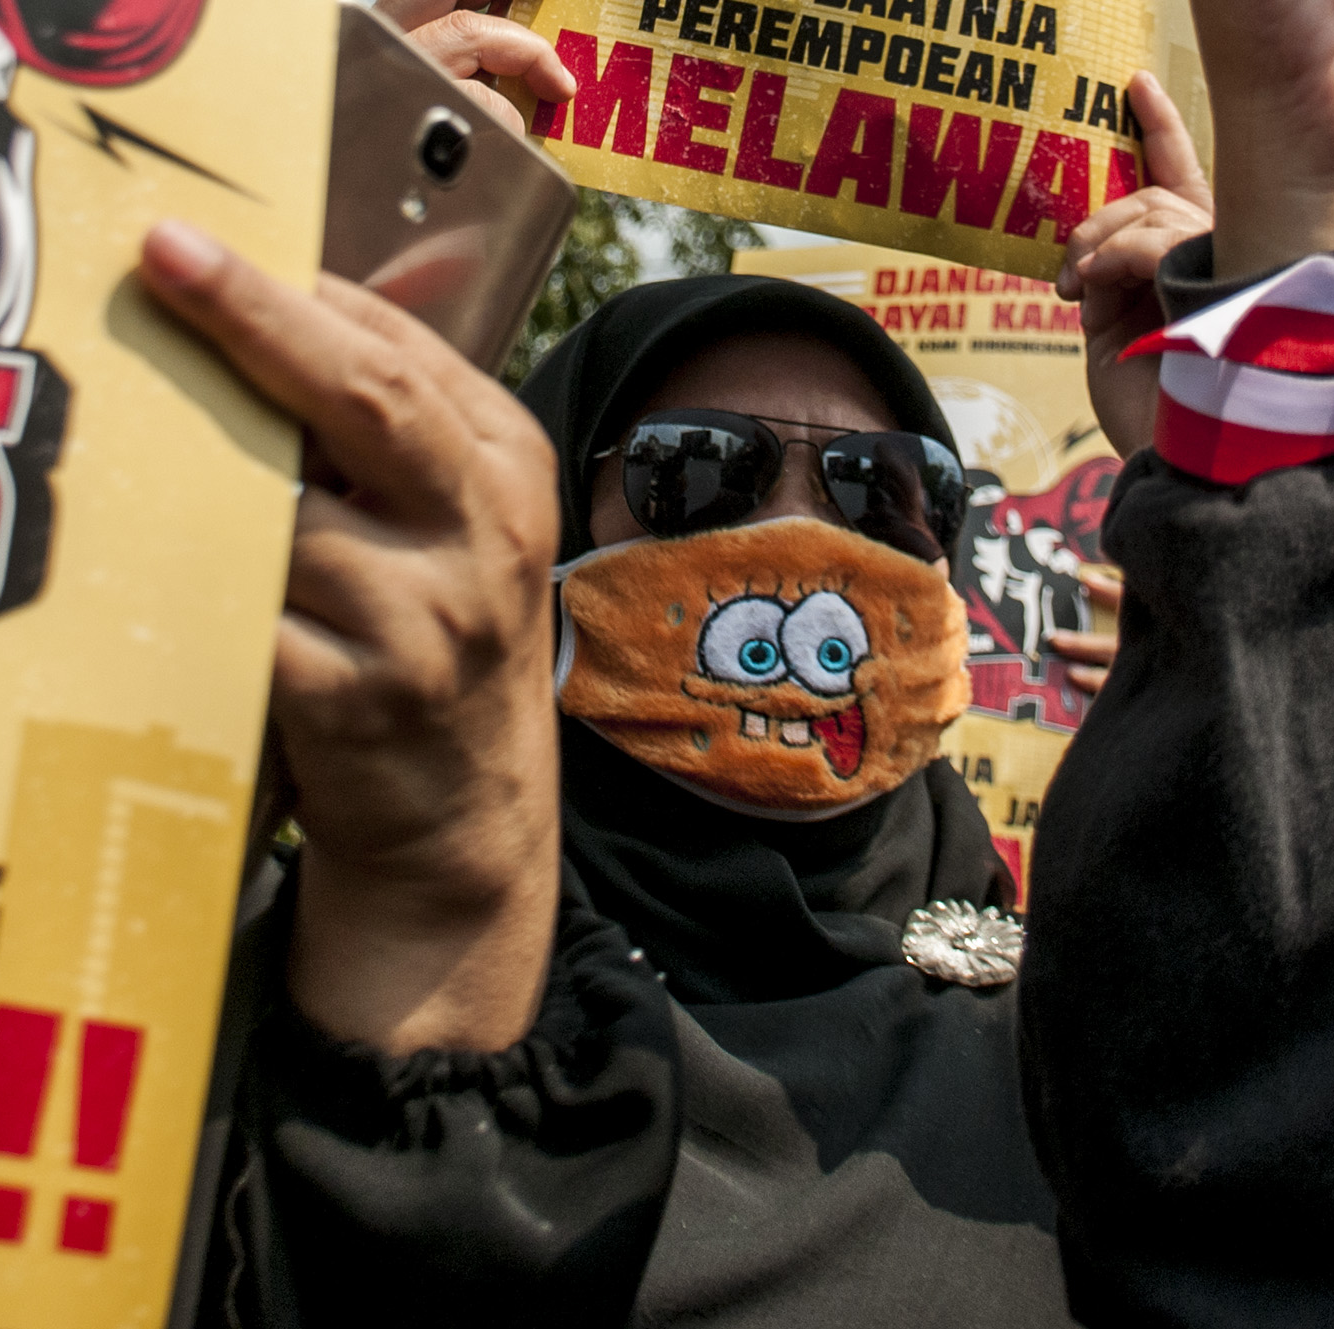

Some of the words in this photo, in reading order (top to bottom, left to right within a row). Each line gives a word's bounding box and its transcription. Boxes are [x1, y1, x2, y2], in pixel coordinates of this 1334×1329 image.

[1063, 75, 1144, 142] JA
[861, 302, 966, 331] AYAI
[992, 302, 1082, 333] KAM
